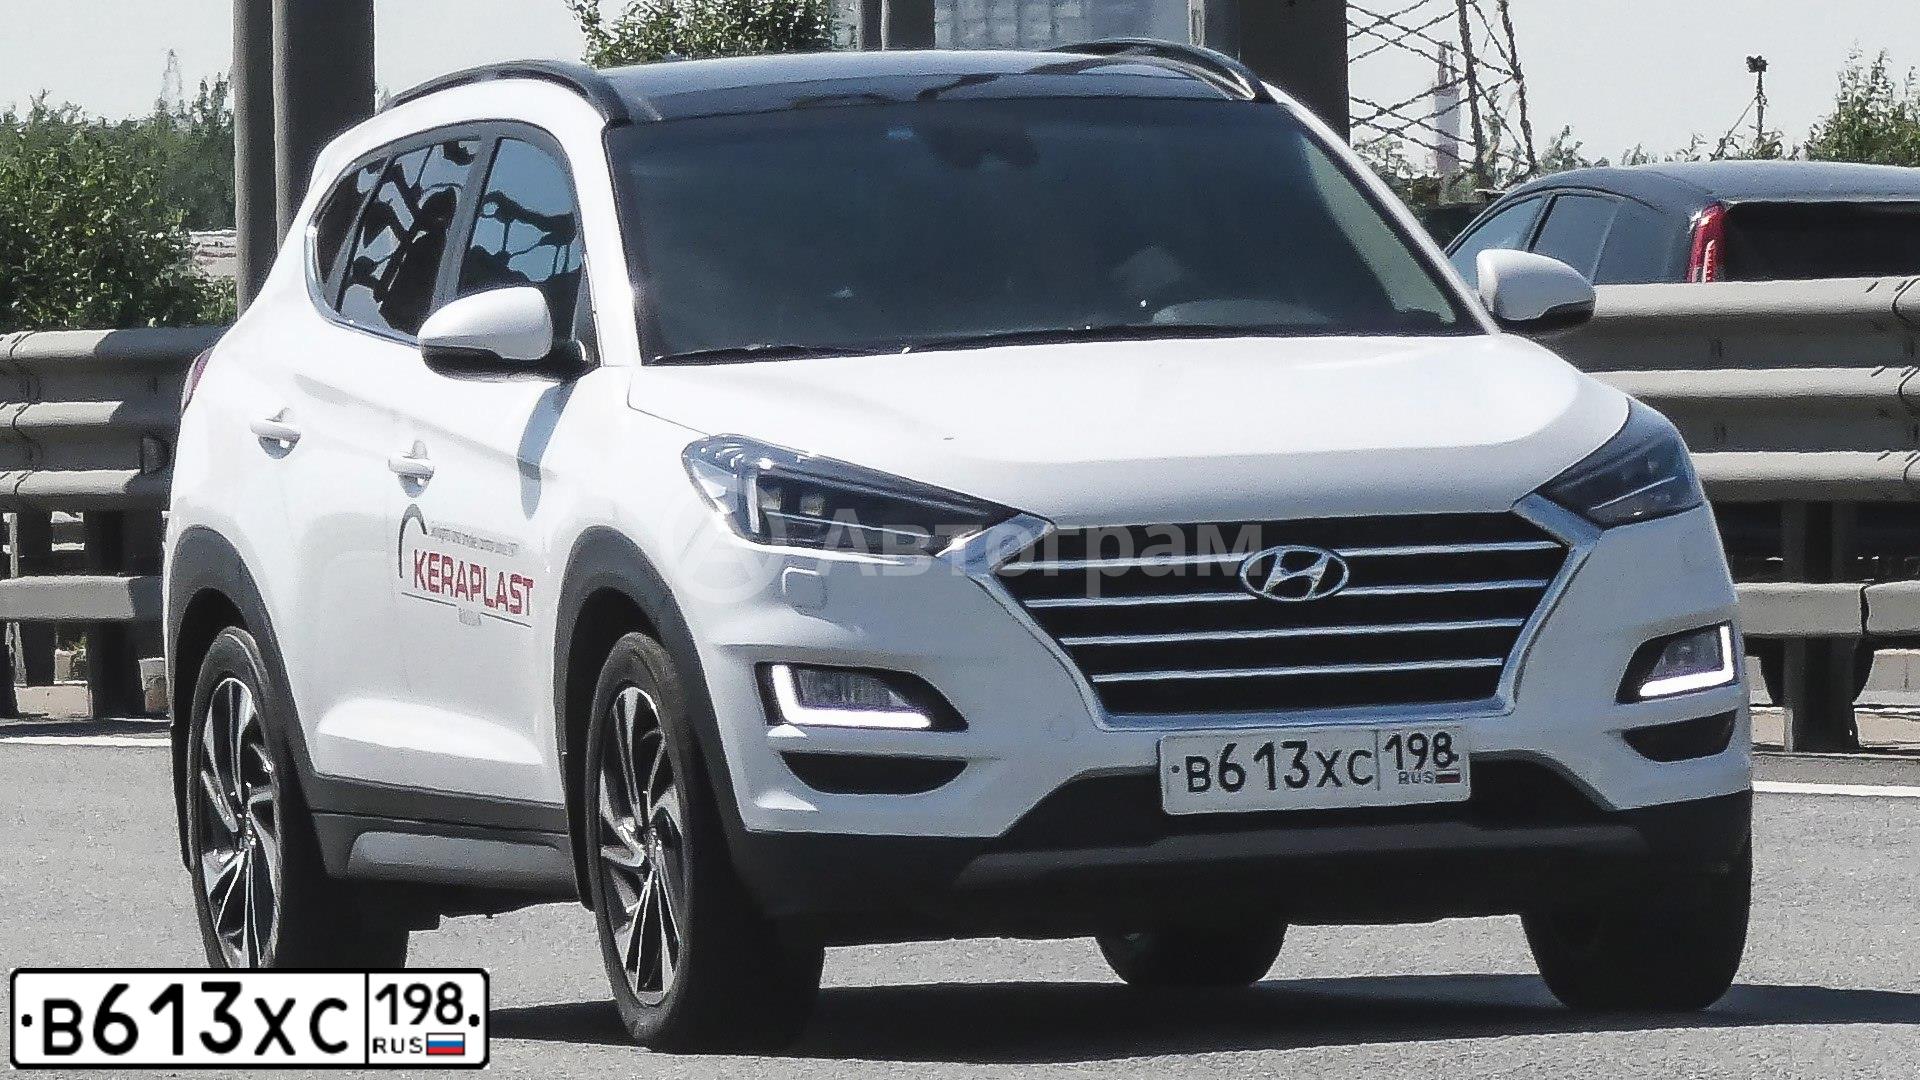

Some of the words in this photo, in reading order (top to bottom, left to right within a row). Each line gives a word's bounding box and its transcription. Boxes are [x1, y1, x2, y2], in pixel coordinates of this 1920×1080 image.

[413, 549, 534, 616] KERAPLAST
[1185, 739, 1373, 793] В613ХС
[1384, 731, 1454, 770] 198
[1398, 770, 1436, 785] RUS
